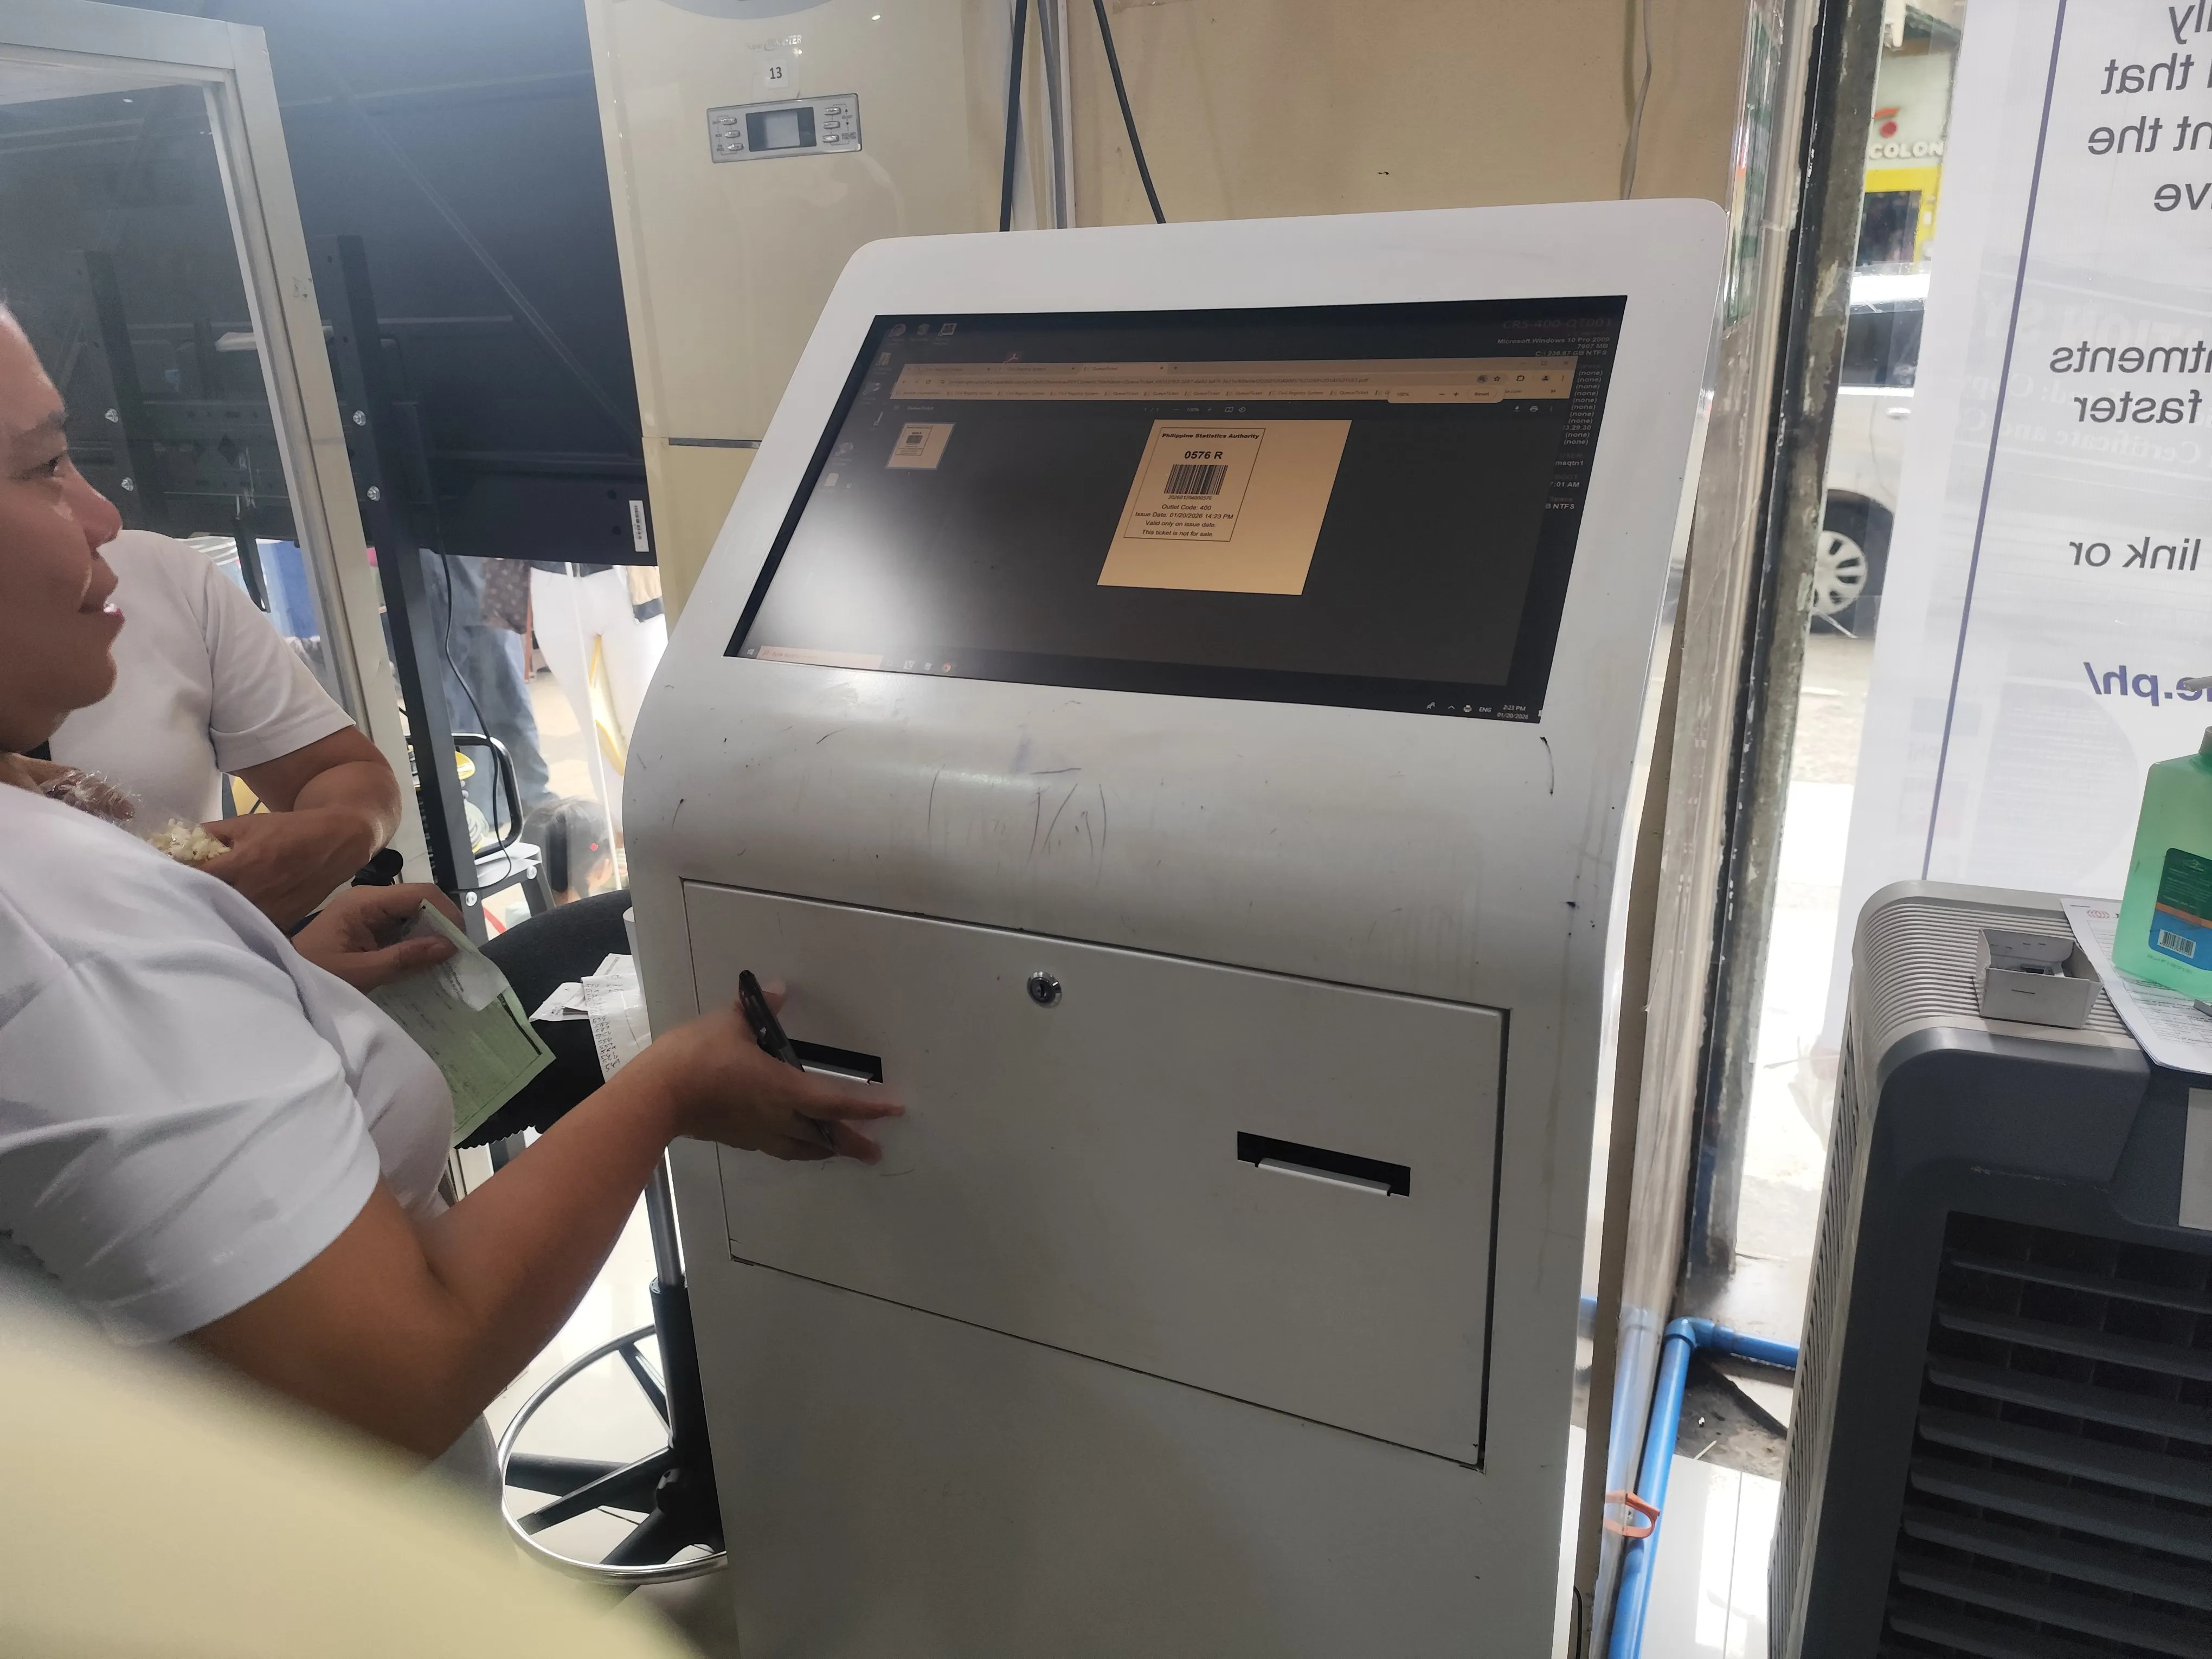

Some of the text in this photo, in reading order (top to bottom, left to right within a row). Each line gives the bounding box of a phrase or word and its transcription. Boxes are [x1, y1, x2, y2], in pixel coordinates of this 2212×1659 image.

[769, 66, 782, 80] 13
[1869, 140, 1945, 159] COLON
[1184, 451, 1223, 459] 0576 R
